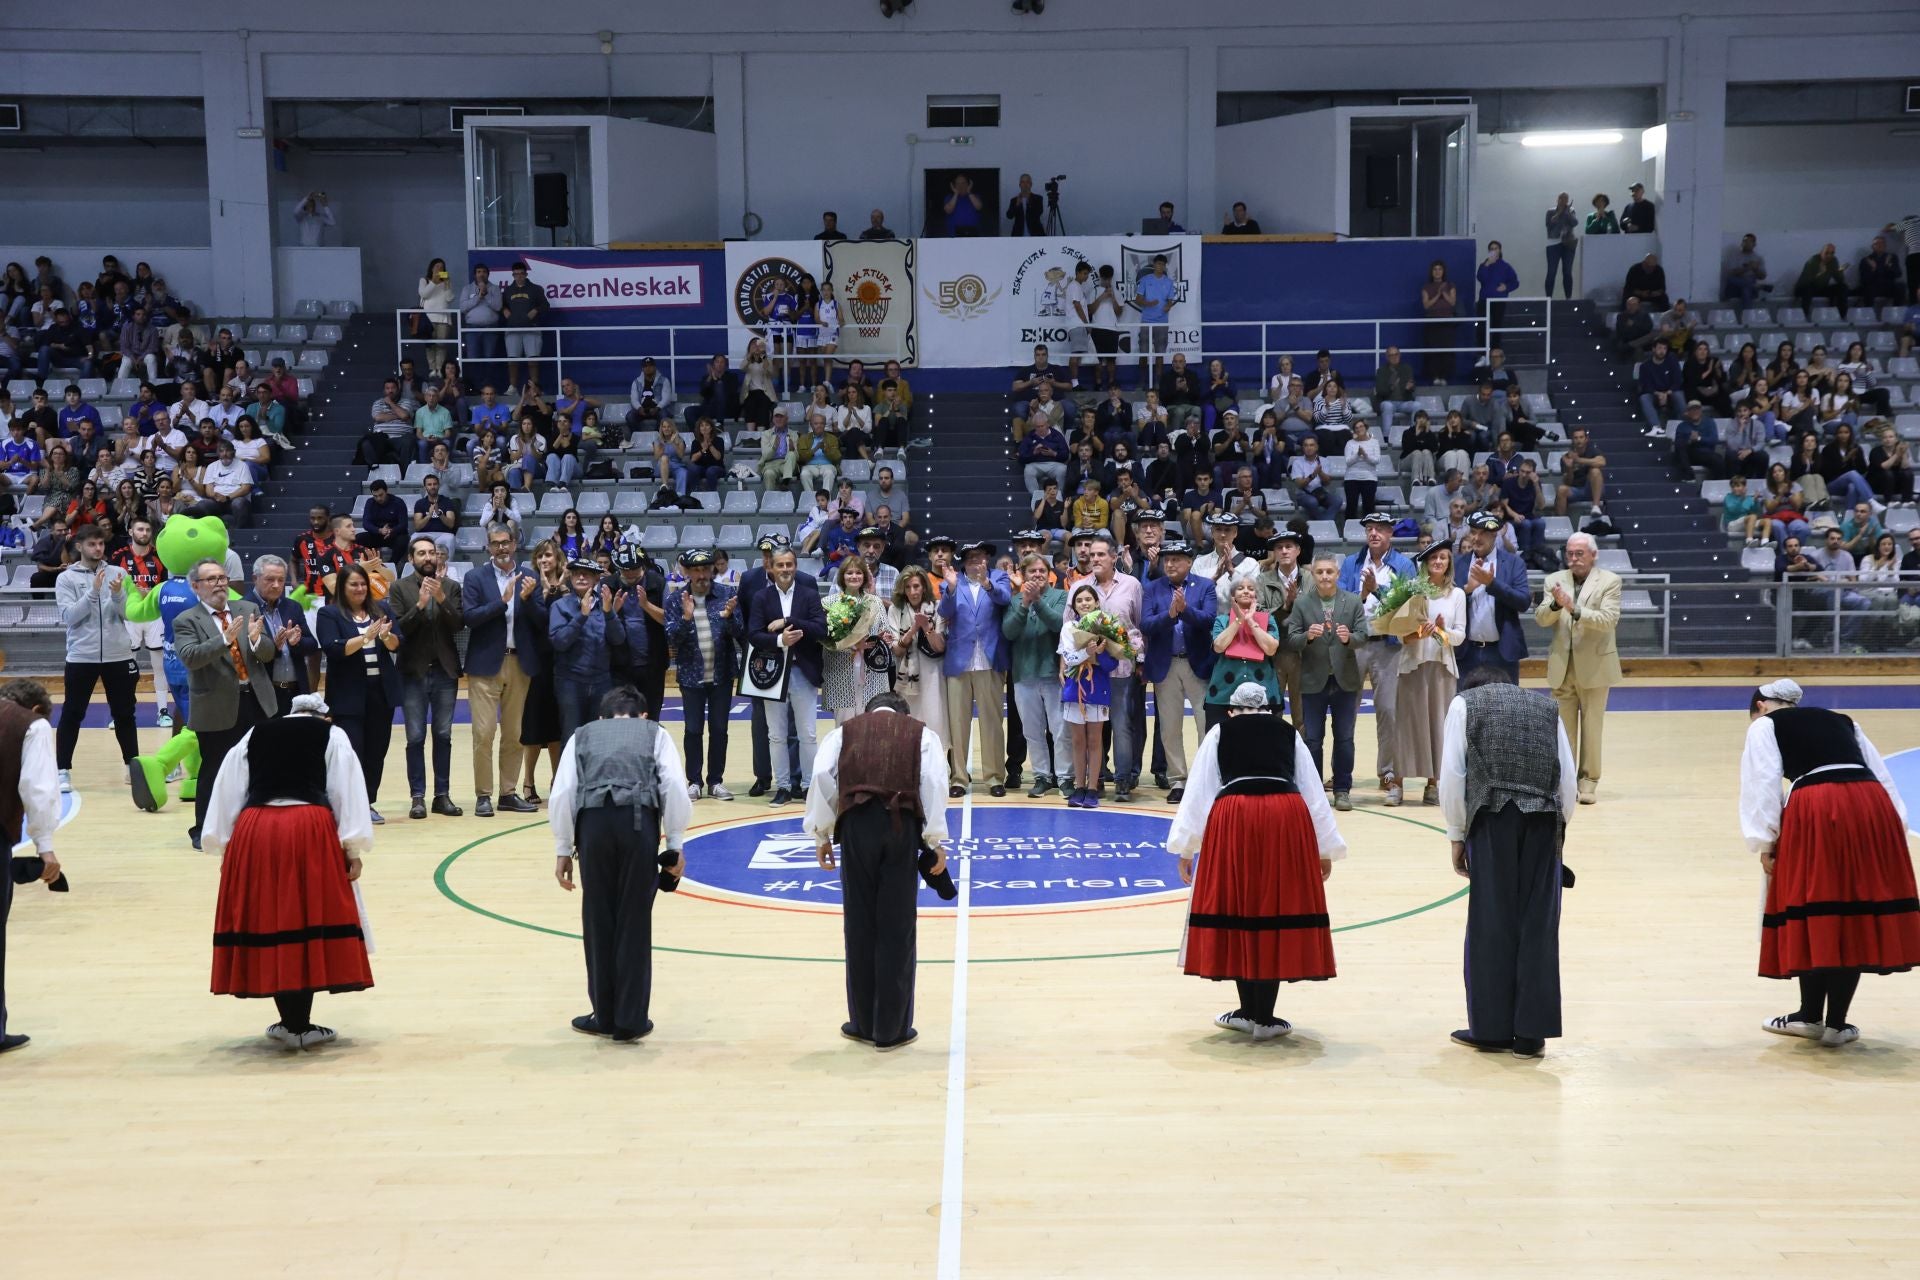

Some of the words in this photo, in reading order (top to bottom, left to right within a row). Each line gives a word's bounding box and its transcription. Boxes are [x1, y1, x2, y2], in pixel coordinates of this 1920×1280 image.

[845, 268, 894, 293] ASKATUAK
[1013, 247, 1048, 295] ASKATUAK
[740, 263, 770, 316] DONOSTIA
[1053, 851, 1141, 860] Kirola
